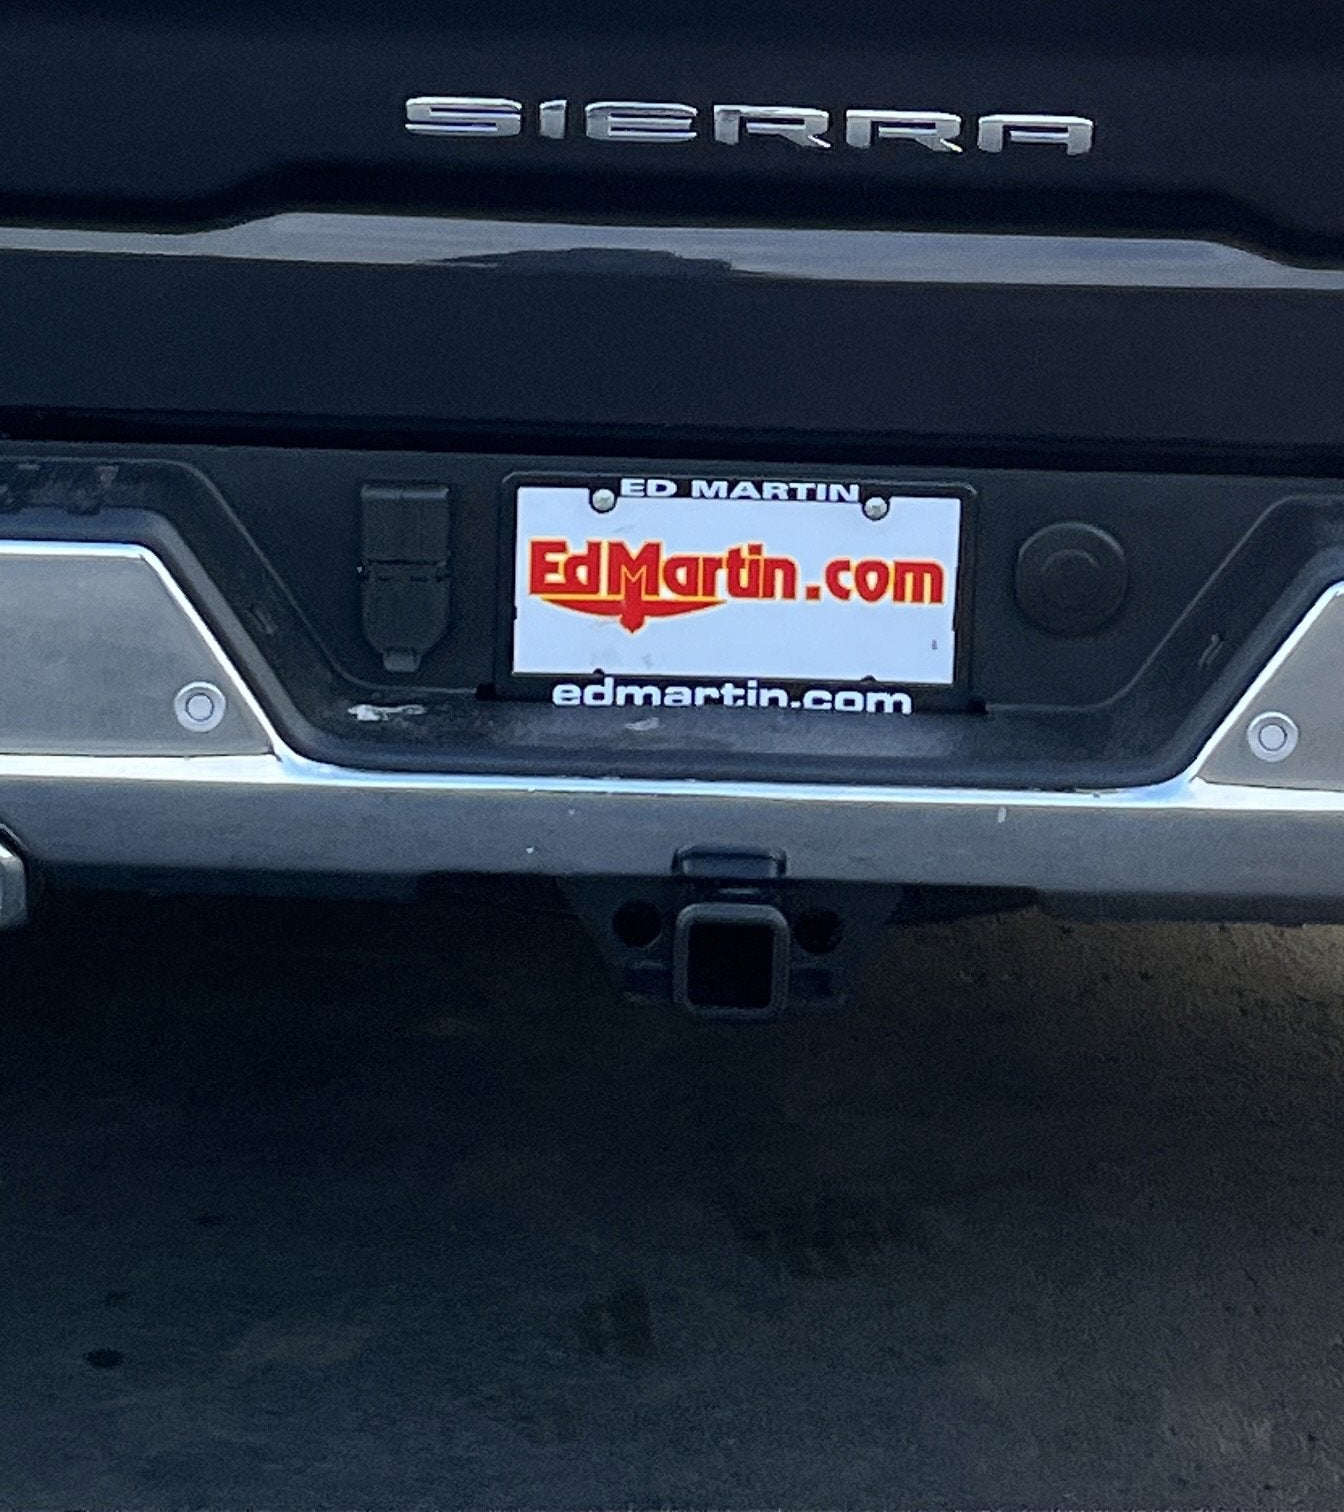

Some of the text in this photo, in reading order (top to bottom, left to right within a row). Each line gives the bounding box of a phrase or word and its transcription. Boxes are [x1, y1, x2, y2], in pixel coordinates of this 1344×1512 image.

[405, 96, 1095, 156] SIERRA
[620, 477, 861, 504] ED MARTIN
[551, 676, 913, 716] edmartin.com
